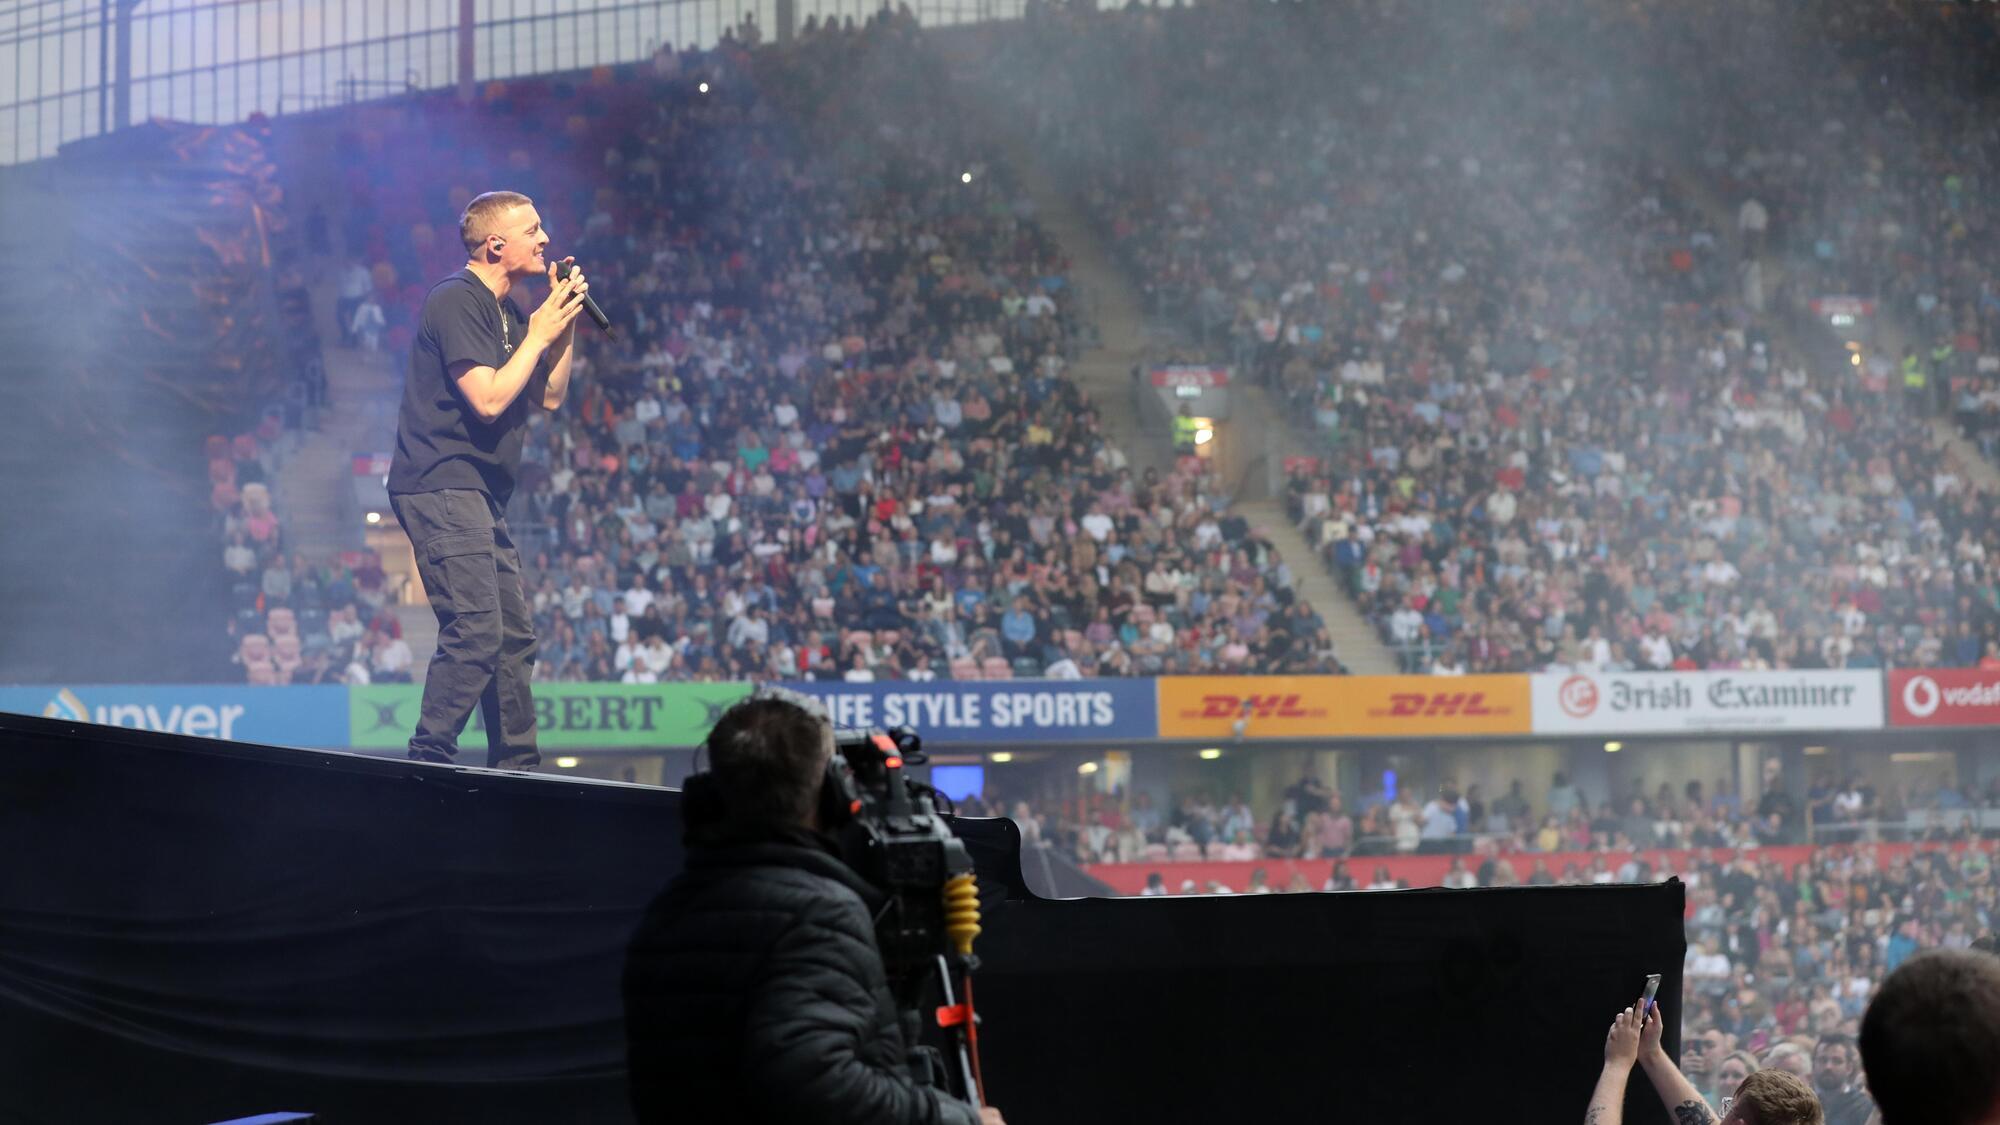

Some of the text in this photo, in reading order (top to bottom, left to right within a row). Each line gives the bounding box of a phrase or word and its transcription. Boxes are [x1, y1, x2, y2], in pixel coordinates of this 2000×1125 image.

[818, 691, 1115, 728] IFE STYLE SPORTS
[1201, 693, 1307, 719] DHL
[1389, 692, 1491, 717] DHL
[1609, 679, 1693, 712] Irish
[1707, 678, 1857, 710] Examiner
[471, 696, 663, 731] BERT
